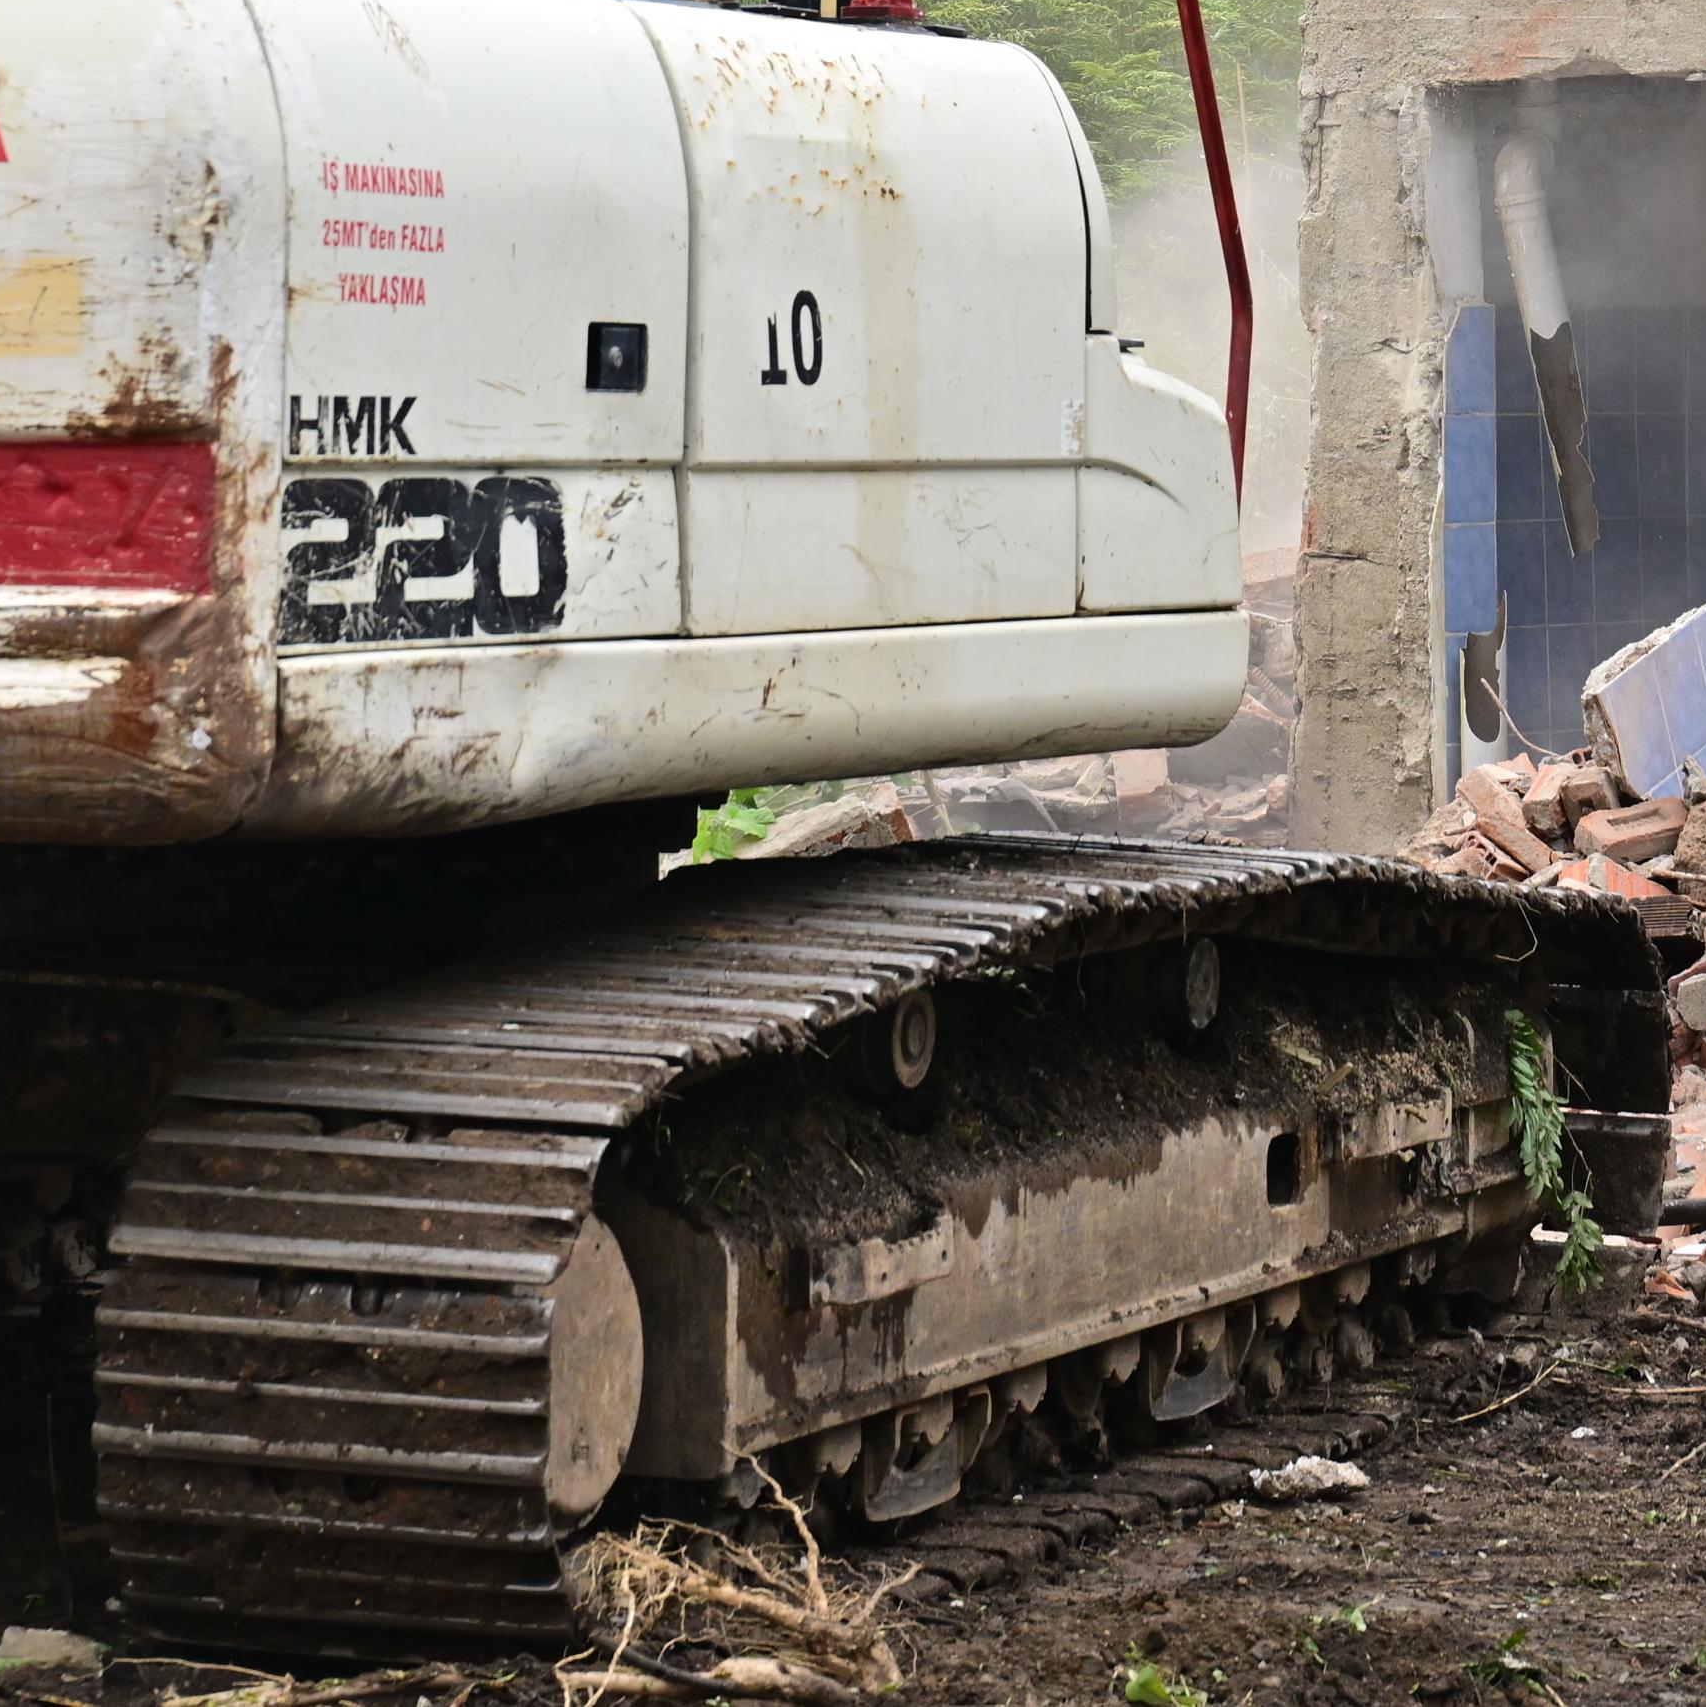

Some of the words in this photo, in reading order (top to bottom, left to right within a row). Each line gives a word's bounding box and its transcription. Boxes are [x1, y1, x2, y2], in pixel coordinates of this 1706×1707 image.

[401, 223, 445, 253] FAZLA
[339, 272, 426, 313] YAKLAŞMA
[289, 394, 418, 455] HMK
[280, 476, 568, 644] 220
